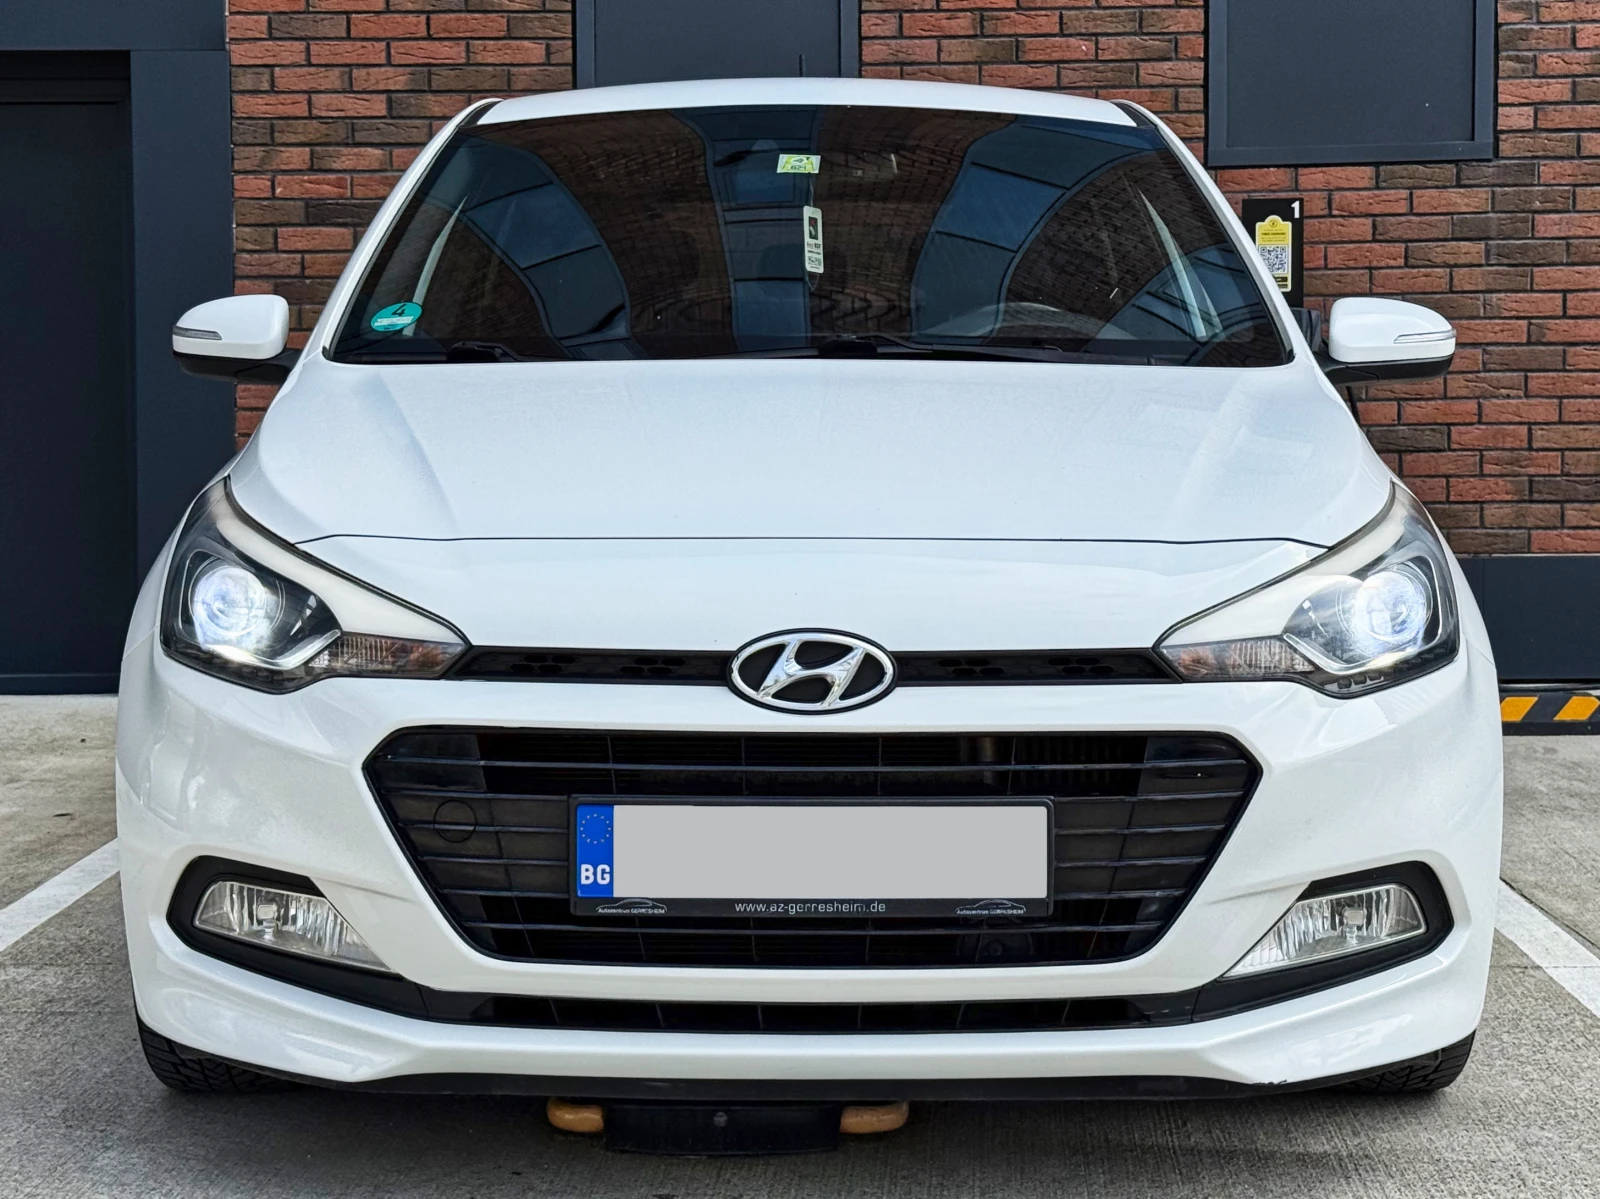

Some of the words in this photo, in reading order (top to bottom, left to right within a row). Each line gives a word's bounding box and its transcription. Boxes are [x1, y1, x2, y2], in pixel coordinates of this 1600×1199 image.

[1291, 200, 1300, 218] 1
[391, 303, 407, 316] 4
[580, 863, 611, 885] BG
[734, 901, 886, 914] www.az-gerresheim.de
